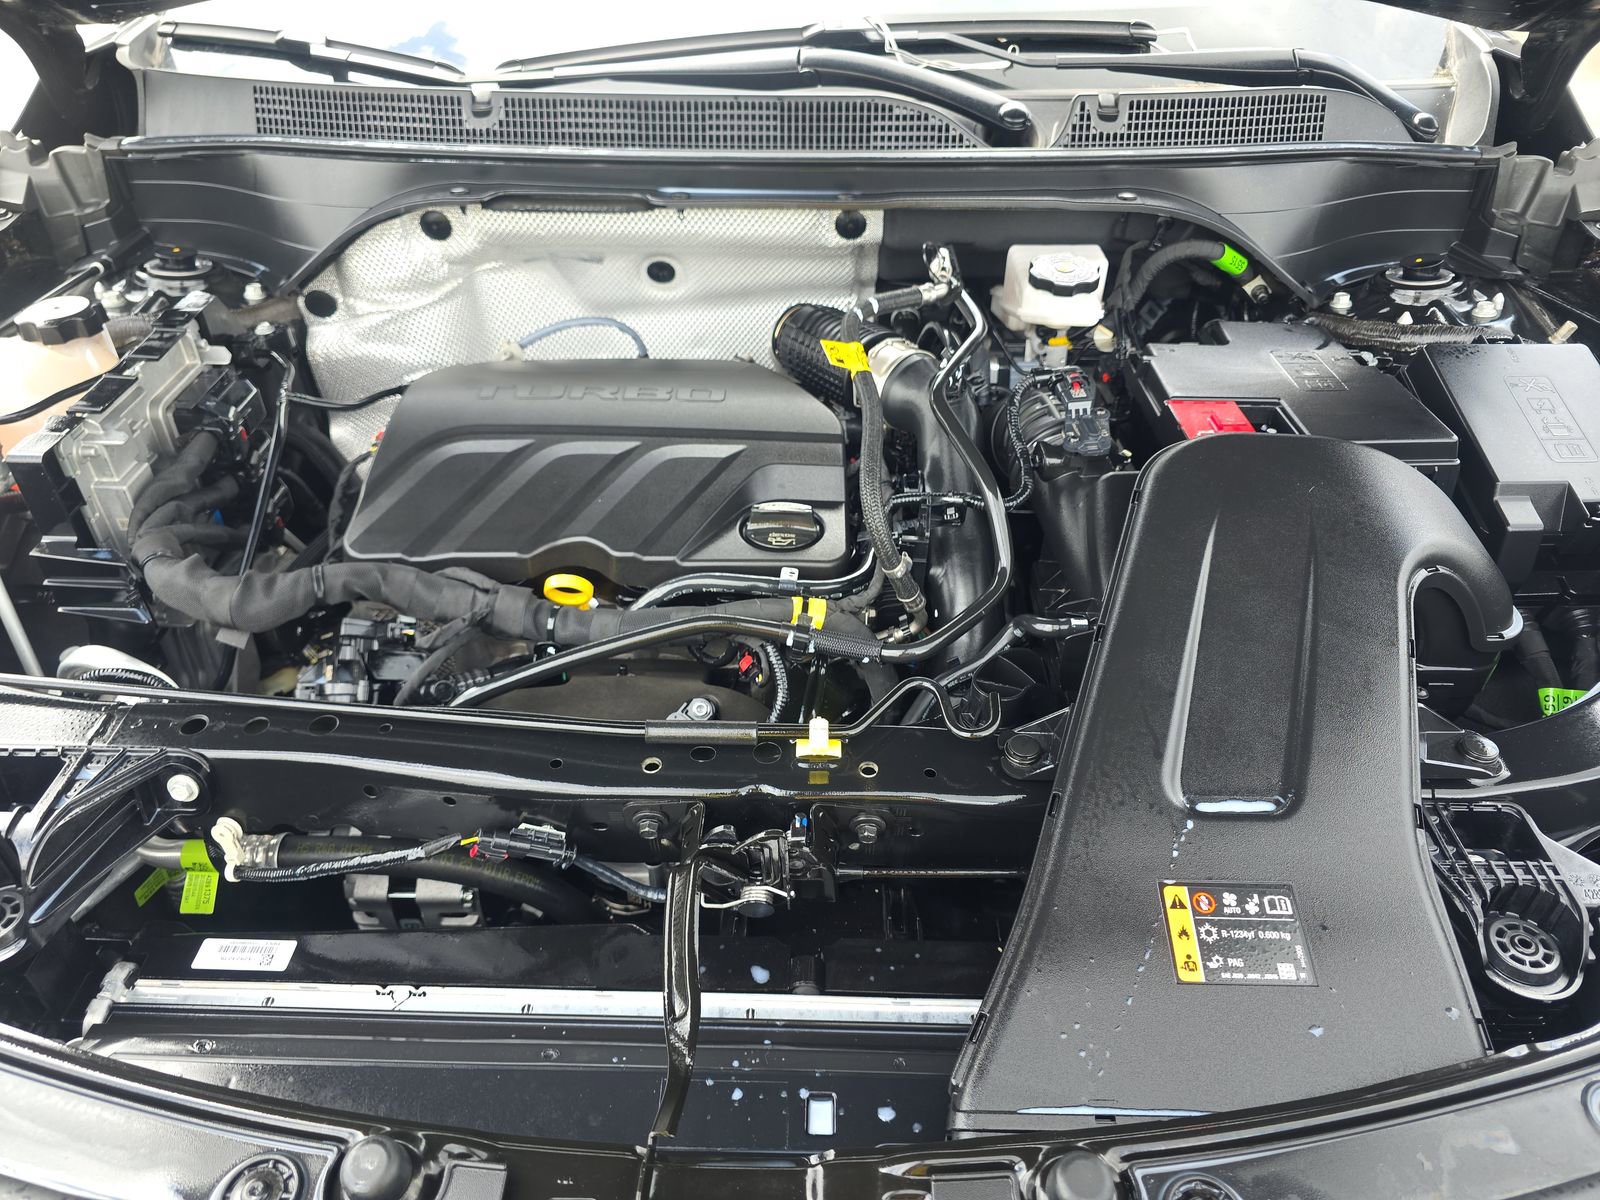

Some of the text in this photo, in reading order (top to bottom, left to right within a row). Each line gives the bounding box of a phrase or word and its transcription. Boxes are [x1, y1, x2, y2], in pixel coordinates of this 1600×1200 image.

[477, 384, 727, 402] TURBO
[1223, 906, 1241, 914] AUTO
[1221, 930, 1291, 941] R-1234yf 0.600 kg
[1227, 957, 1244, 967] PAG
